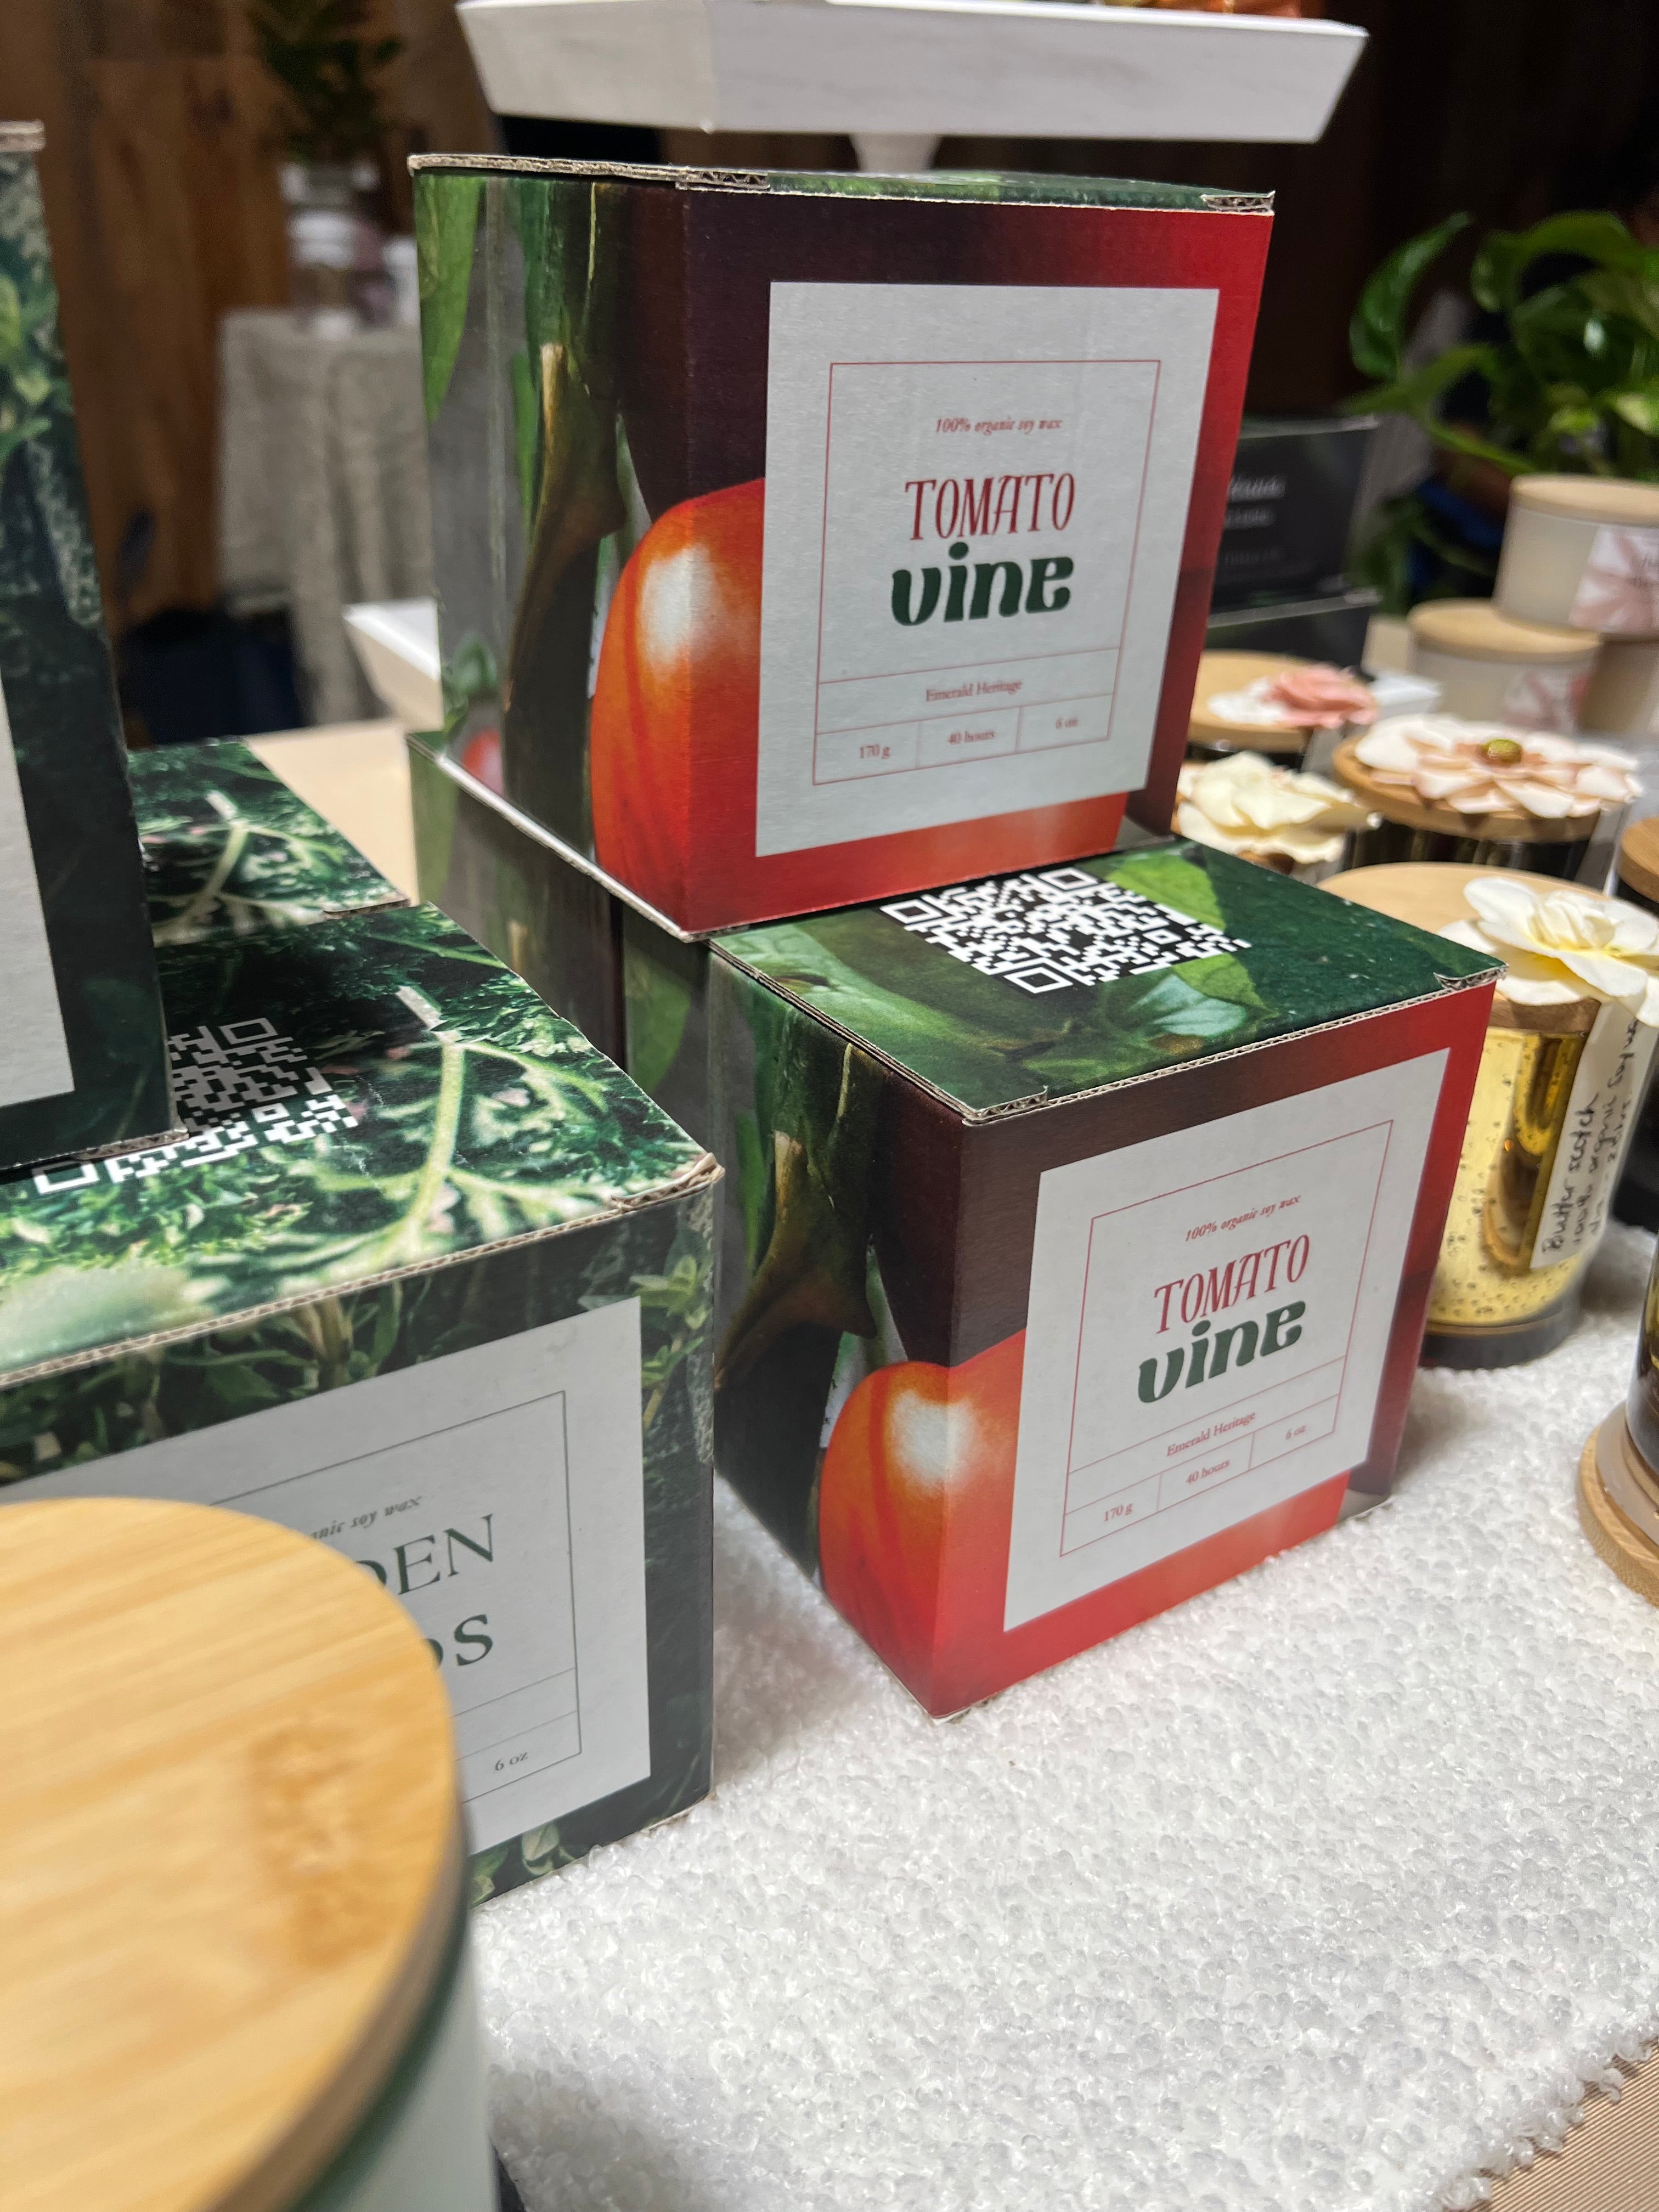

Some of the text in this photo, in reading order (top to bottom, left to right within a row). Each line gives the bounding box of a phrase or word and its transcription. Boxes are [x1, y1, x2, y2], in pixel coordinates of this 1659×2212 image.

[936, 418, 970, 432] 100%
[905, 472, 1075, 540] TOMATO
[891, 541, 1074, 627] vine
[926, 681, 1023, 702] Emerald Heritage
[949, 730, 995, 744] 40 hours
[860, 744, 891, 759] 170 g
[1186, 1195, 1301, 1242] 100% organic soy wax
[1154, 1234, 1310, 1334] TOMATO
[1138, 1300, 1306, 1404] vine
[1166, 1413, 1255, 1456] Emerald Heritage
[1285, 1429, 1292, 1440] 6
[1186, 1460, 1229, 1483] 40 hours
[351, 1511, 377, 1528] soy
[385, 1496, 422, 1516] wax
[1103, 1503, 1133, 1521] 170 g
[494, 1752, 528, 1771] 6 oz
